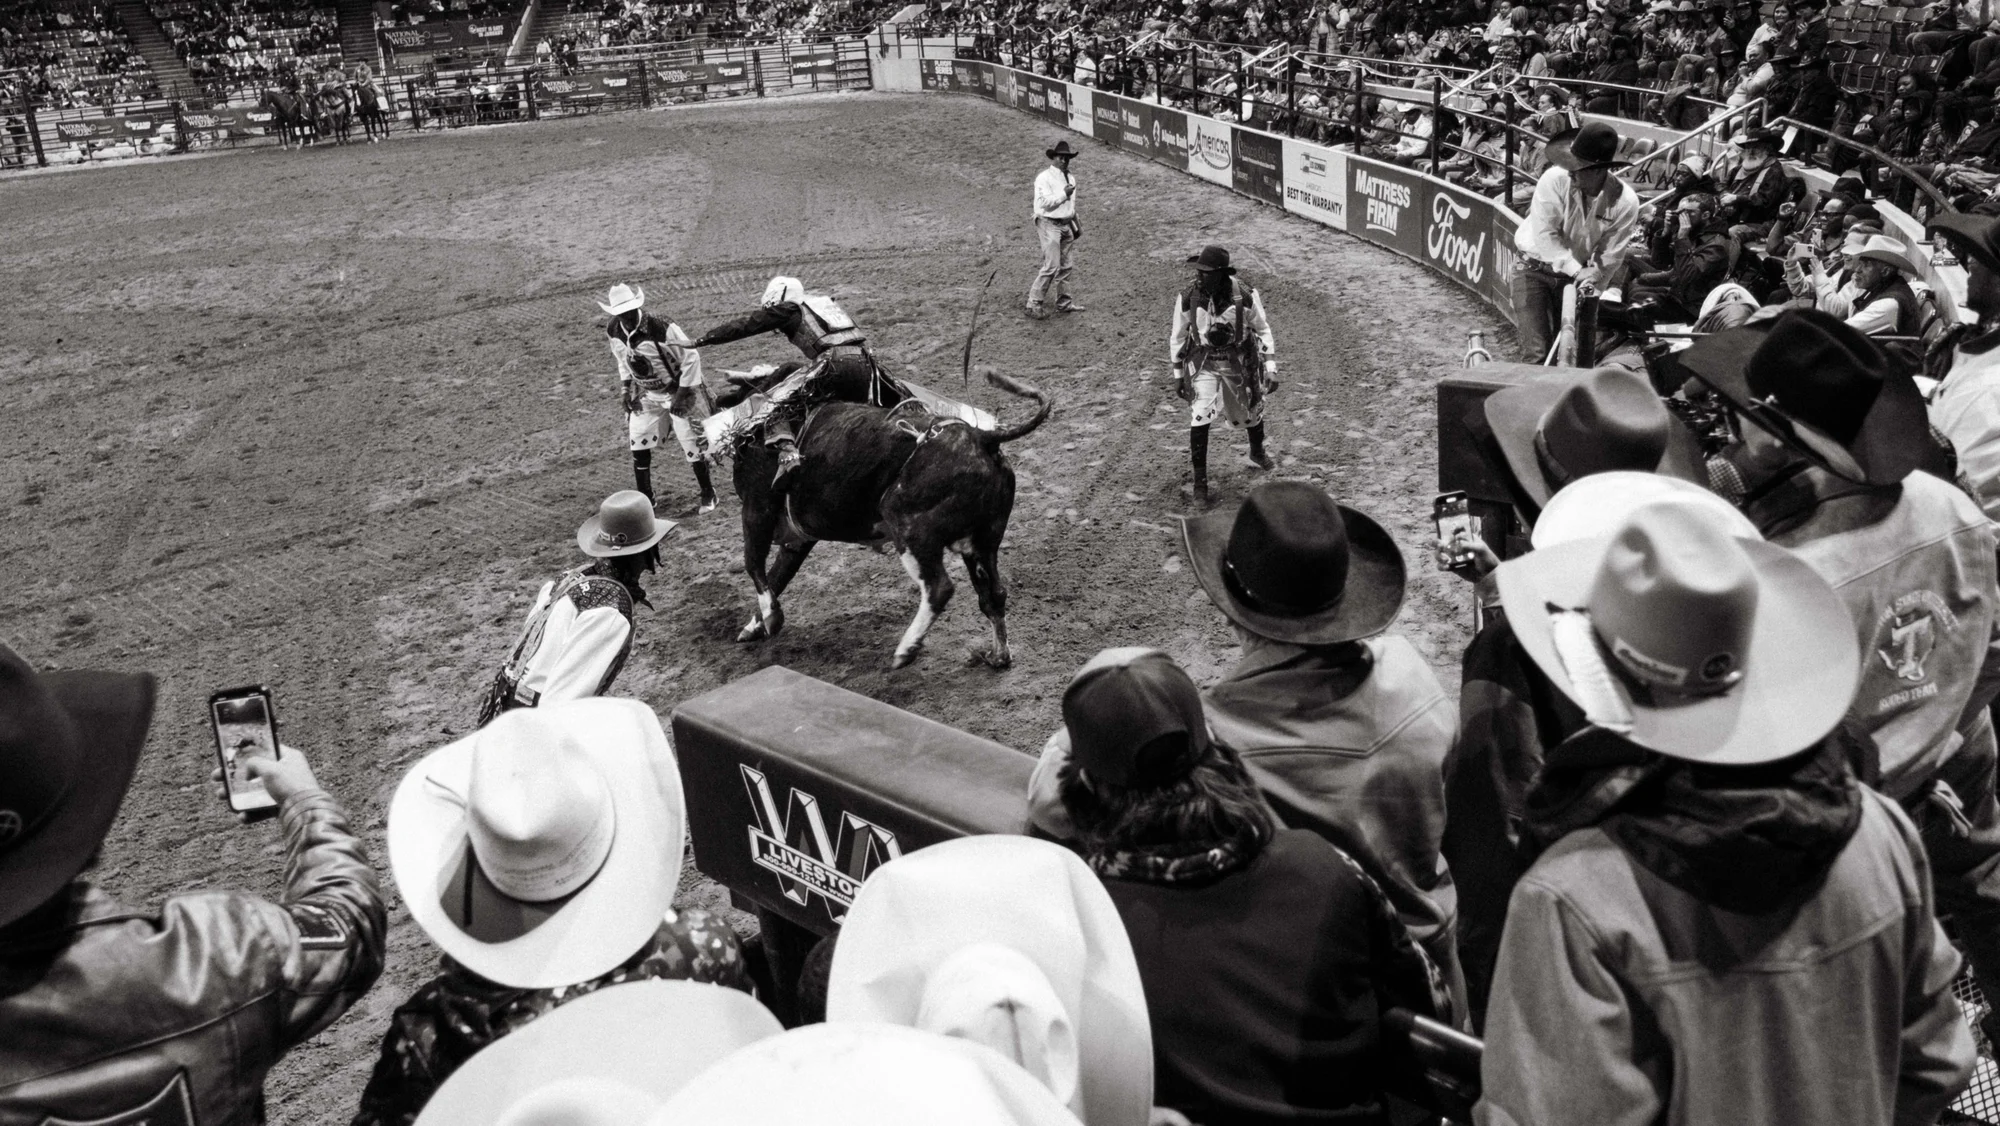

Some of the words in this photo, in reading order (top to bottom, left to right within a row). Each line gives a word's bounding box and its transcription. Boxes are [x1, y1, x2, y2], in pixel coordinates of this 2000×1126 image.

[384, 30, 419, 40] NATIONAL
[1161, 129, 1176, 147] Alpine
[1175, 133, 1188, 150] Bank
[1287, 186, 1299, 200] BEST
[1300, 191, 1311, 206] TIRE
[1311, 195, 1343, 216] WARRANTY
[1355, 169, 1411, 208] MATTRESS
[1366, 198, 1400, 231] FIRM
[1427, 191, 1486, 284] Ford
[1879, 691, 1910, 712] RODEO
[1911, 682, 1938, 700] TEAM
